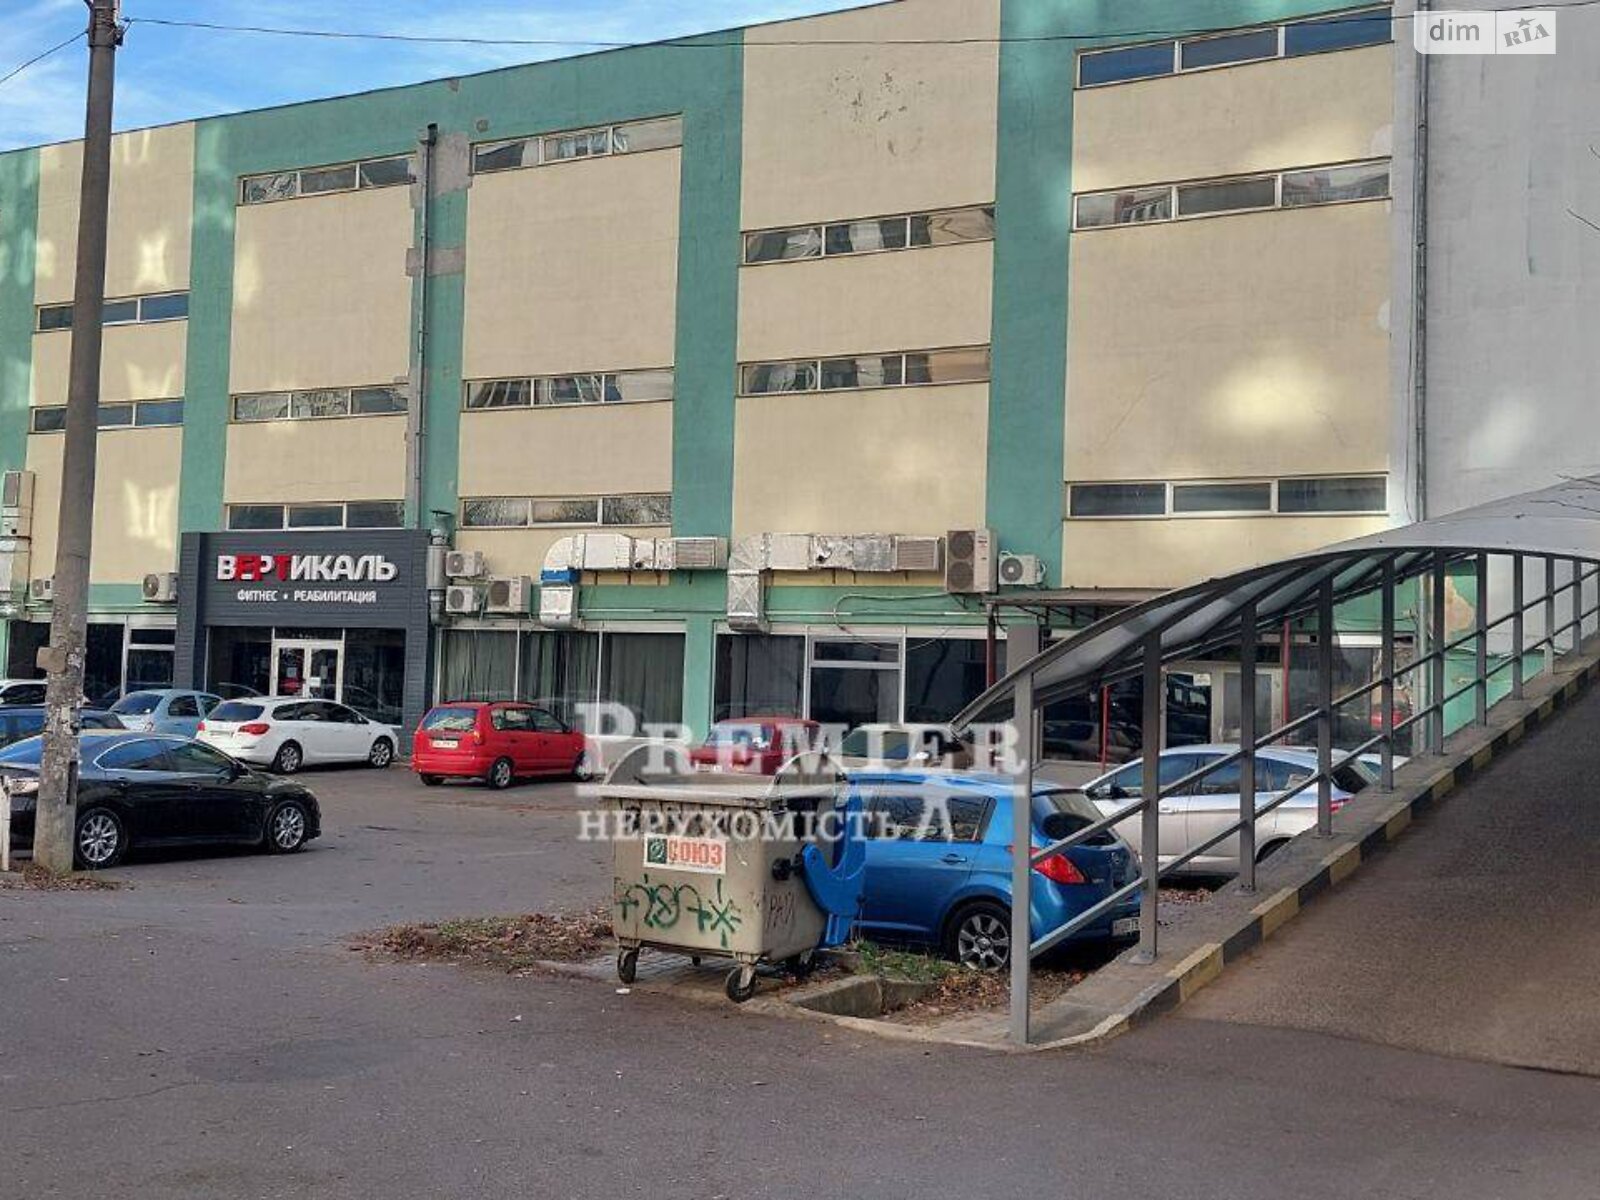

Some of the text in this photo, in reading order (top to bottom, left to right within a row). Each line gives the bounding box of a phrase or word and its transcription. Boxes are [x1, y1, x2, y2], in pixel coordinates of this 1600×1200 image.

[216, 554, 398, 581] ВЕРТИКАЛЬ
[237, 589, 377, 604] ФИТНЕС РЕАБИЛИТАЦИЯ
[668, 839, 723, 866] СОЮЗ
